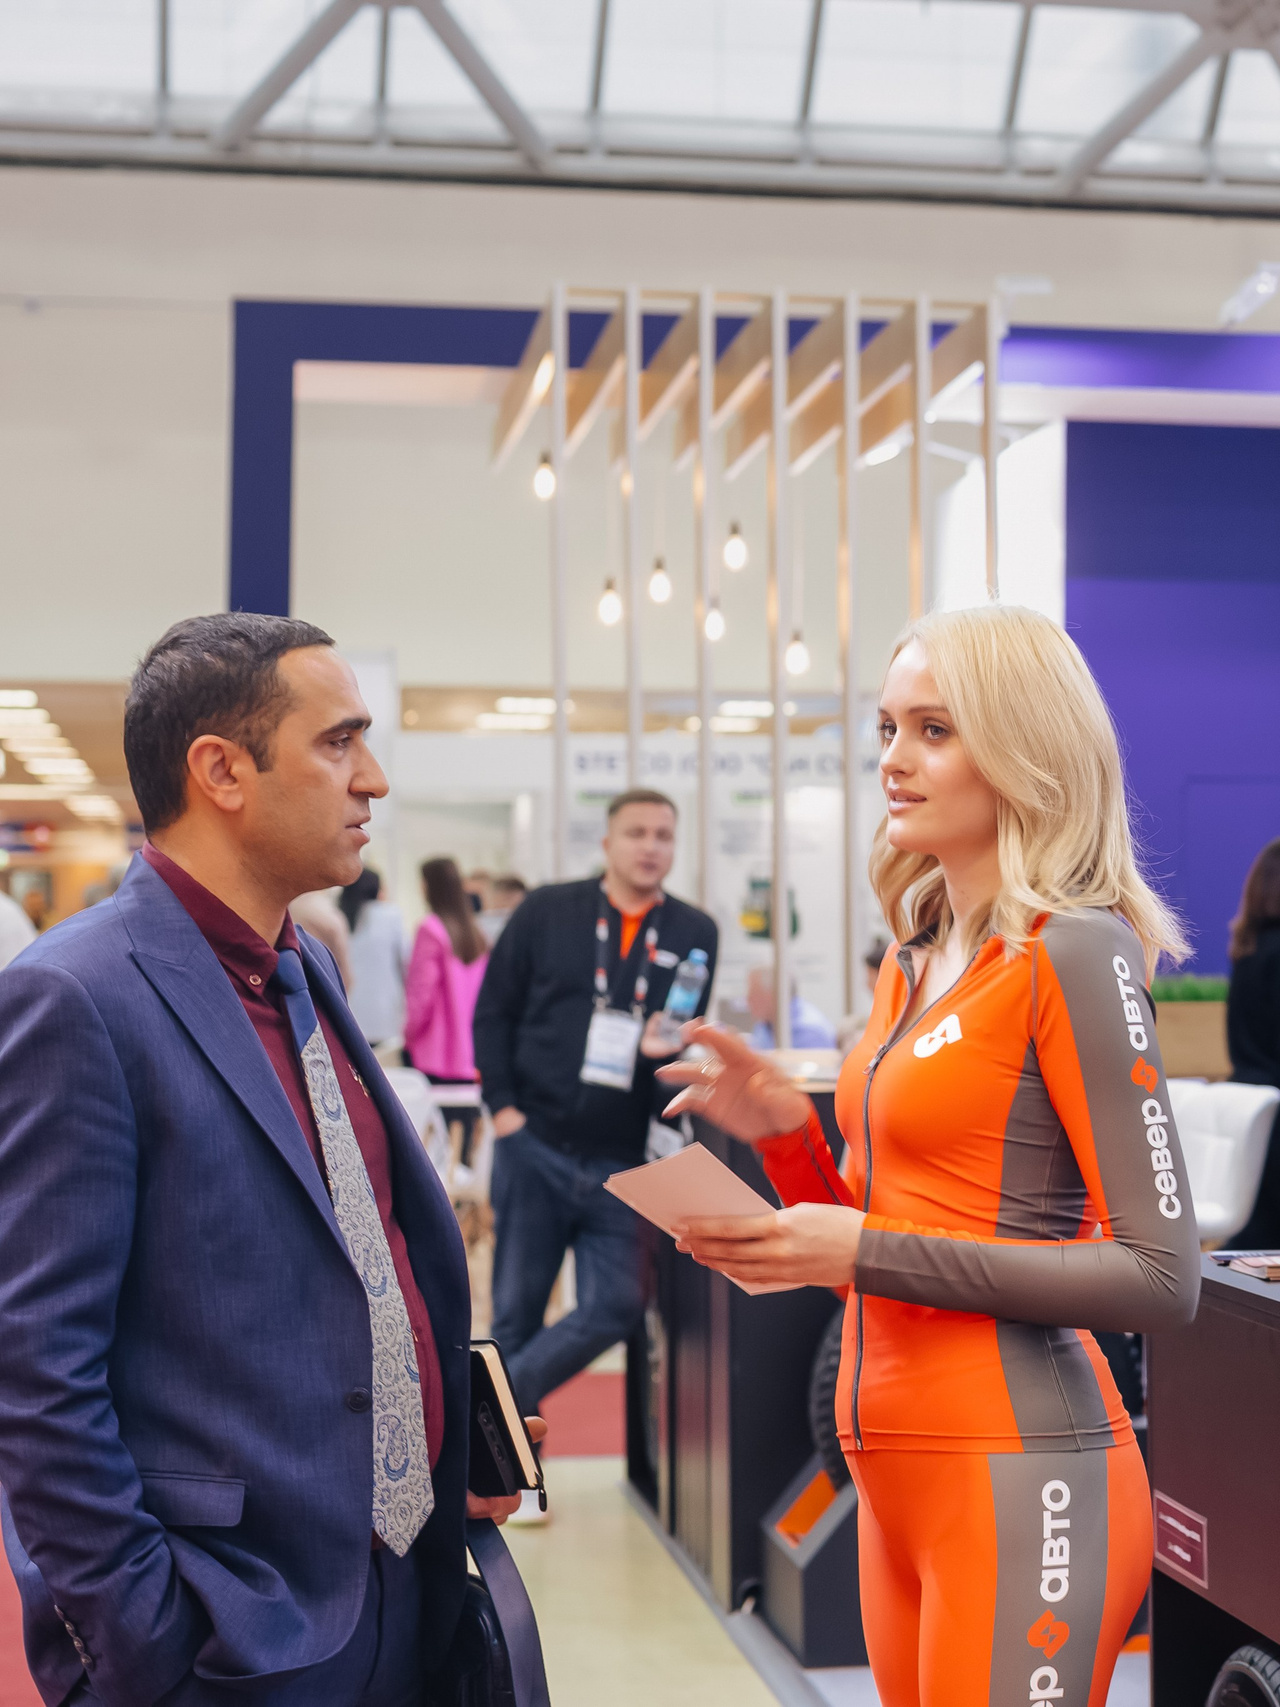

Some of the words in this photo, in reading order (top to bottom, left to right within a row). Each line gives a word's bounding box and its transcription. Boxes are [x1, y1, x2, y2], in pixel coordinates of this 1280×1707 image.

[1112, 954, 1149, 1052] авто
[1141, 1098, 1182, 1220] север
[1039, 1479, 1071, 1603] авто
